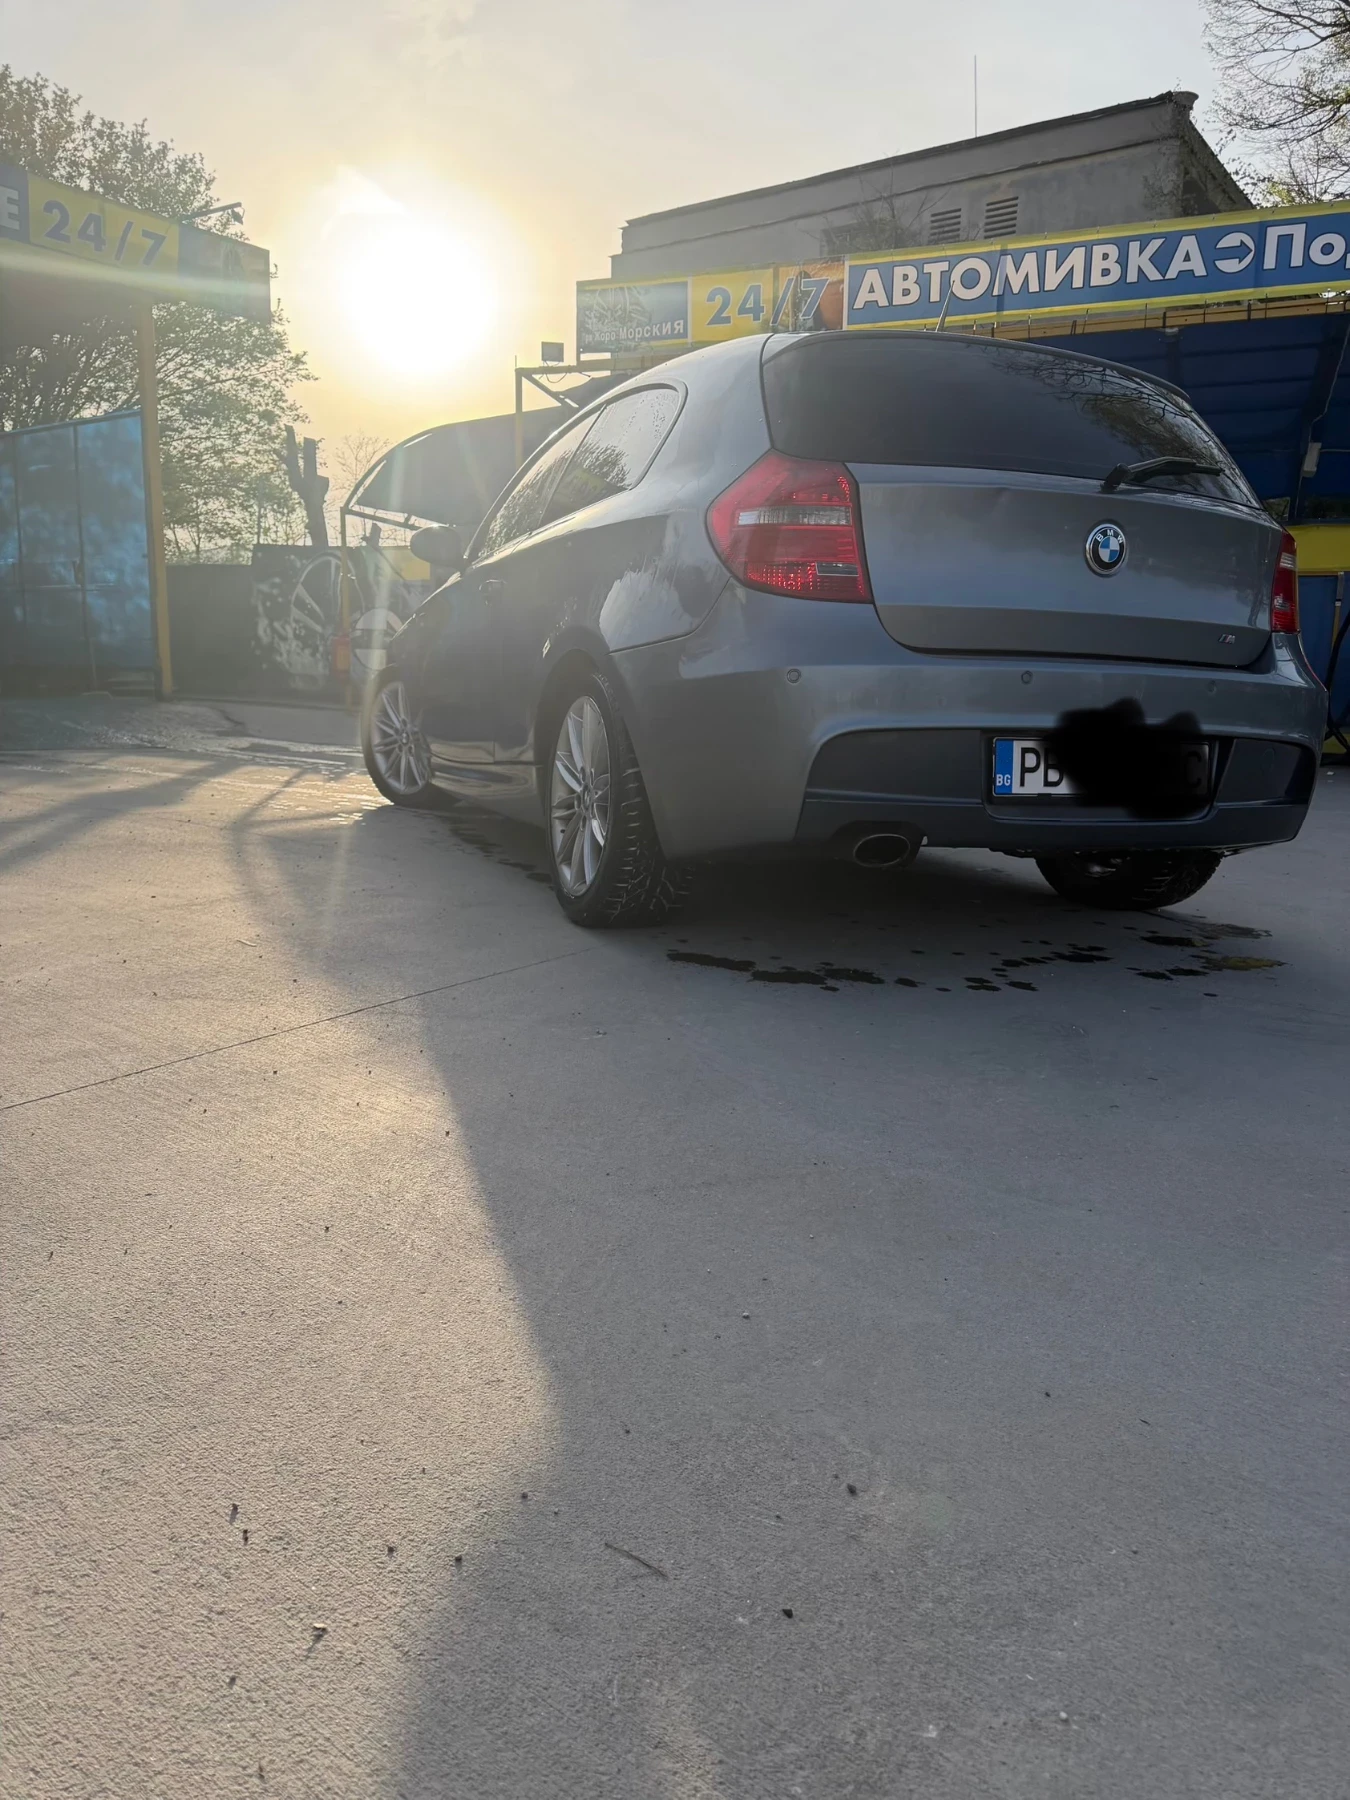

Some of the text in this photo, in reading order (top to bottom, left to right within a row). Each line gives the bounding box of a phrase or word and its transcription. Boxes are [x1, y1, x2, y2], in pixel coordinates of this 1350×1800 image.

[42, 199, 168, 267] 24/7
[852, 222, 1350, 310] АВТОМИВКА По
[705, 275, 830, 327] 24/7
[619, 319, 685, 341] Морския
[1095, 529, 1124, 544] BMW
[996, 773, 1011, 786] BG
